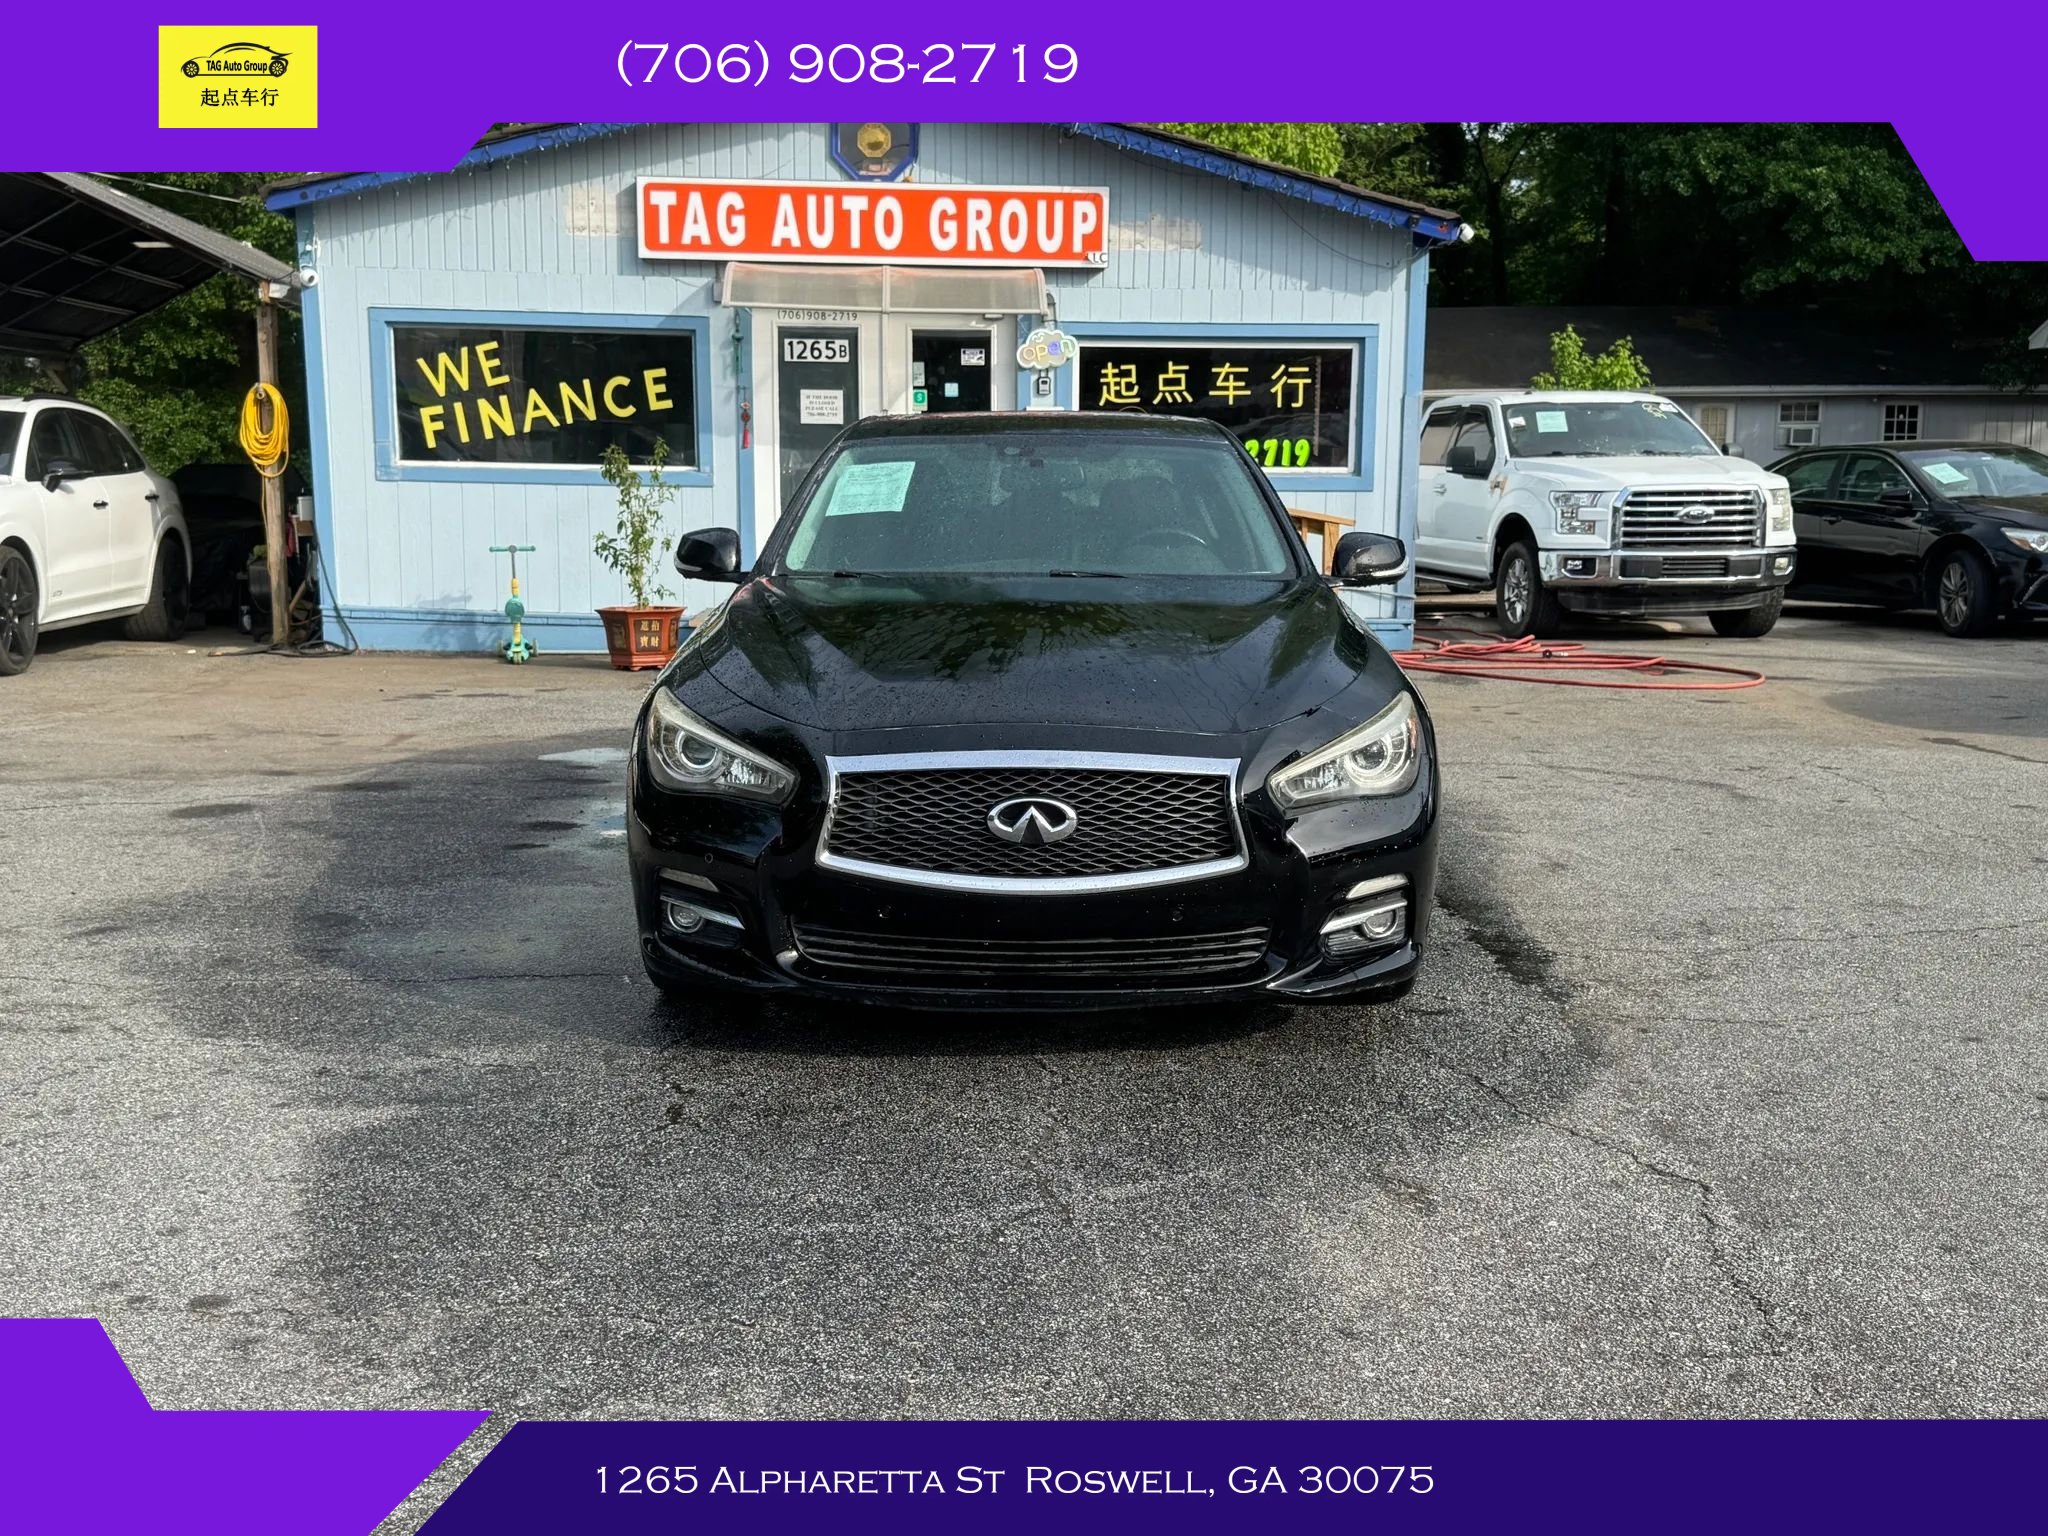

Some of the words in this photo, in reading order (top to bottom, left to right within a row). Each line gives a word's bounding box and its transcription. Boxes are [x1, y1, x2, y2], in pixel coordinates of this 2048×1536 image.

[649, 190, 746, 247] TAG
[771, 194, 904, 251] AUTO
[929, 197, 1099, 255] GROUP
[777, 310, 858, 321] (706)908-2719
[416, 340, 511, 399] WE
[1022, 339, 1074, 362] open
[419, 366, 674, 449] FINANCE
[1098, 360, 1313, 409] 起点车行
